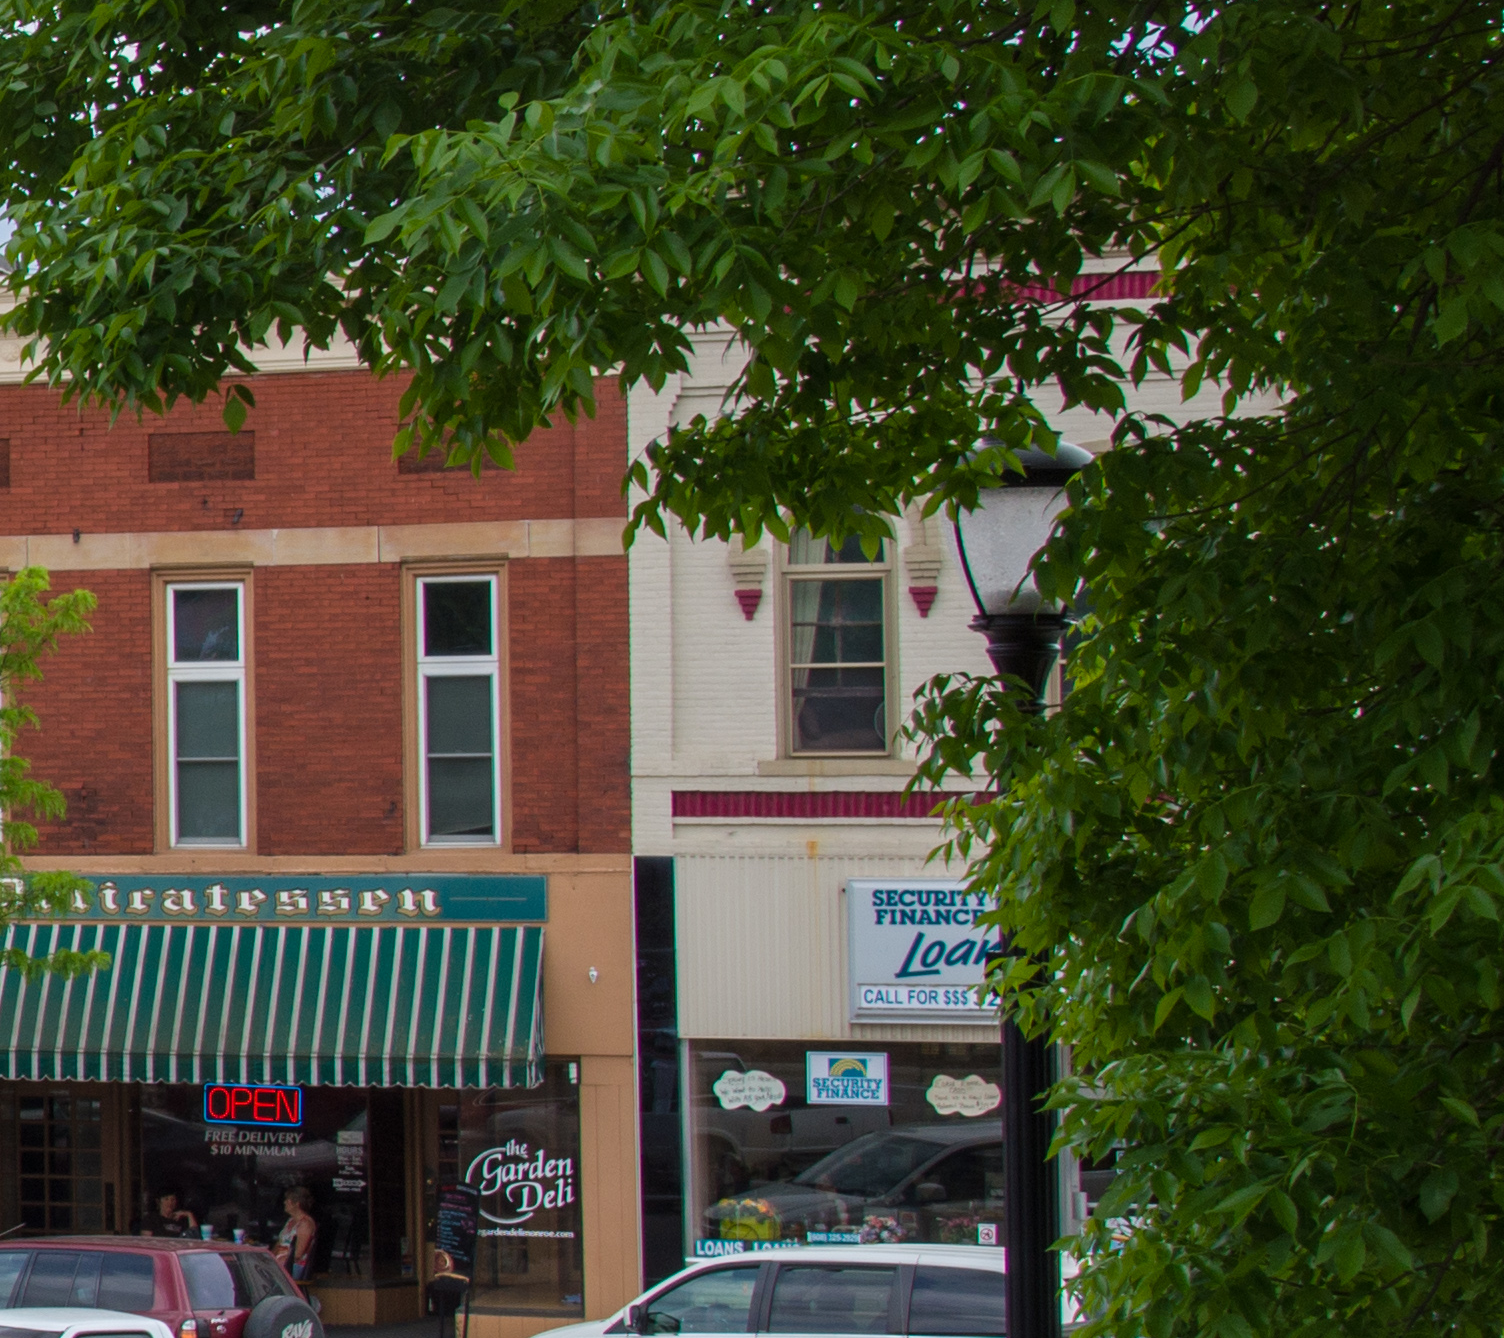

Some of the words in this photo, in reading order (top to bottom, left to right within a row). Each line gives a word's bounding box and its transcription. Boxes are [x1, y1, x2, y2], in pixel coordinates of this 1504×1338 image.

[872, 889, 988, 907] SECURITY
[894, 931, 1002, 978] Loan
[863, 989, 903, 1005] CALL
[908, 989, 939, 1005] FOR
[943, 989, 968, 1006] $$$
[812, 1077, 882, 1089] SECURITY
[816, 1088, 879, 1099] FINANCE
[208, 1086, 298, 1123] OPEN
[204, 1130, 236, 1142] FREE
[238, 1131, 304, 1144] DELIVERY
[210, 1145, 231, 1155] $10
[235, 1145, 296, 1157] MINIMUM
[505, 1138, 529, 1158] the
[479, 1149, 574, 1196] Garden
[506, 1178, 575, 1213] Deli
[696, 1240, 744, 1256] LOANS
